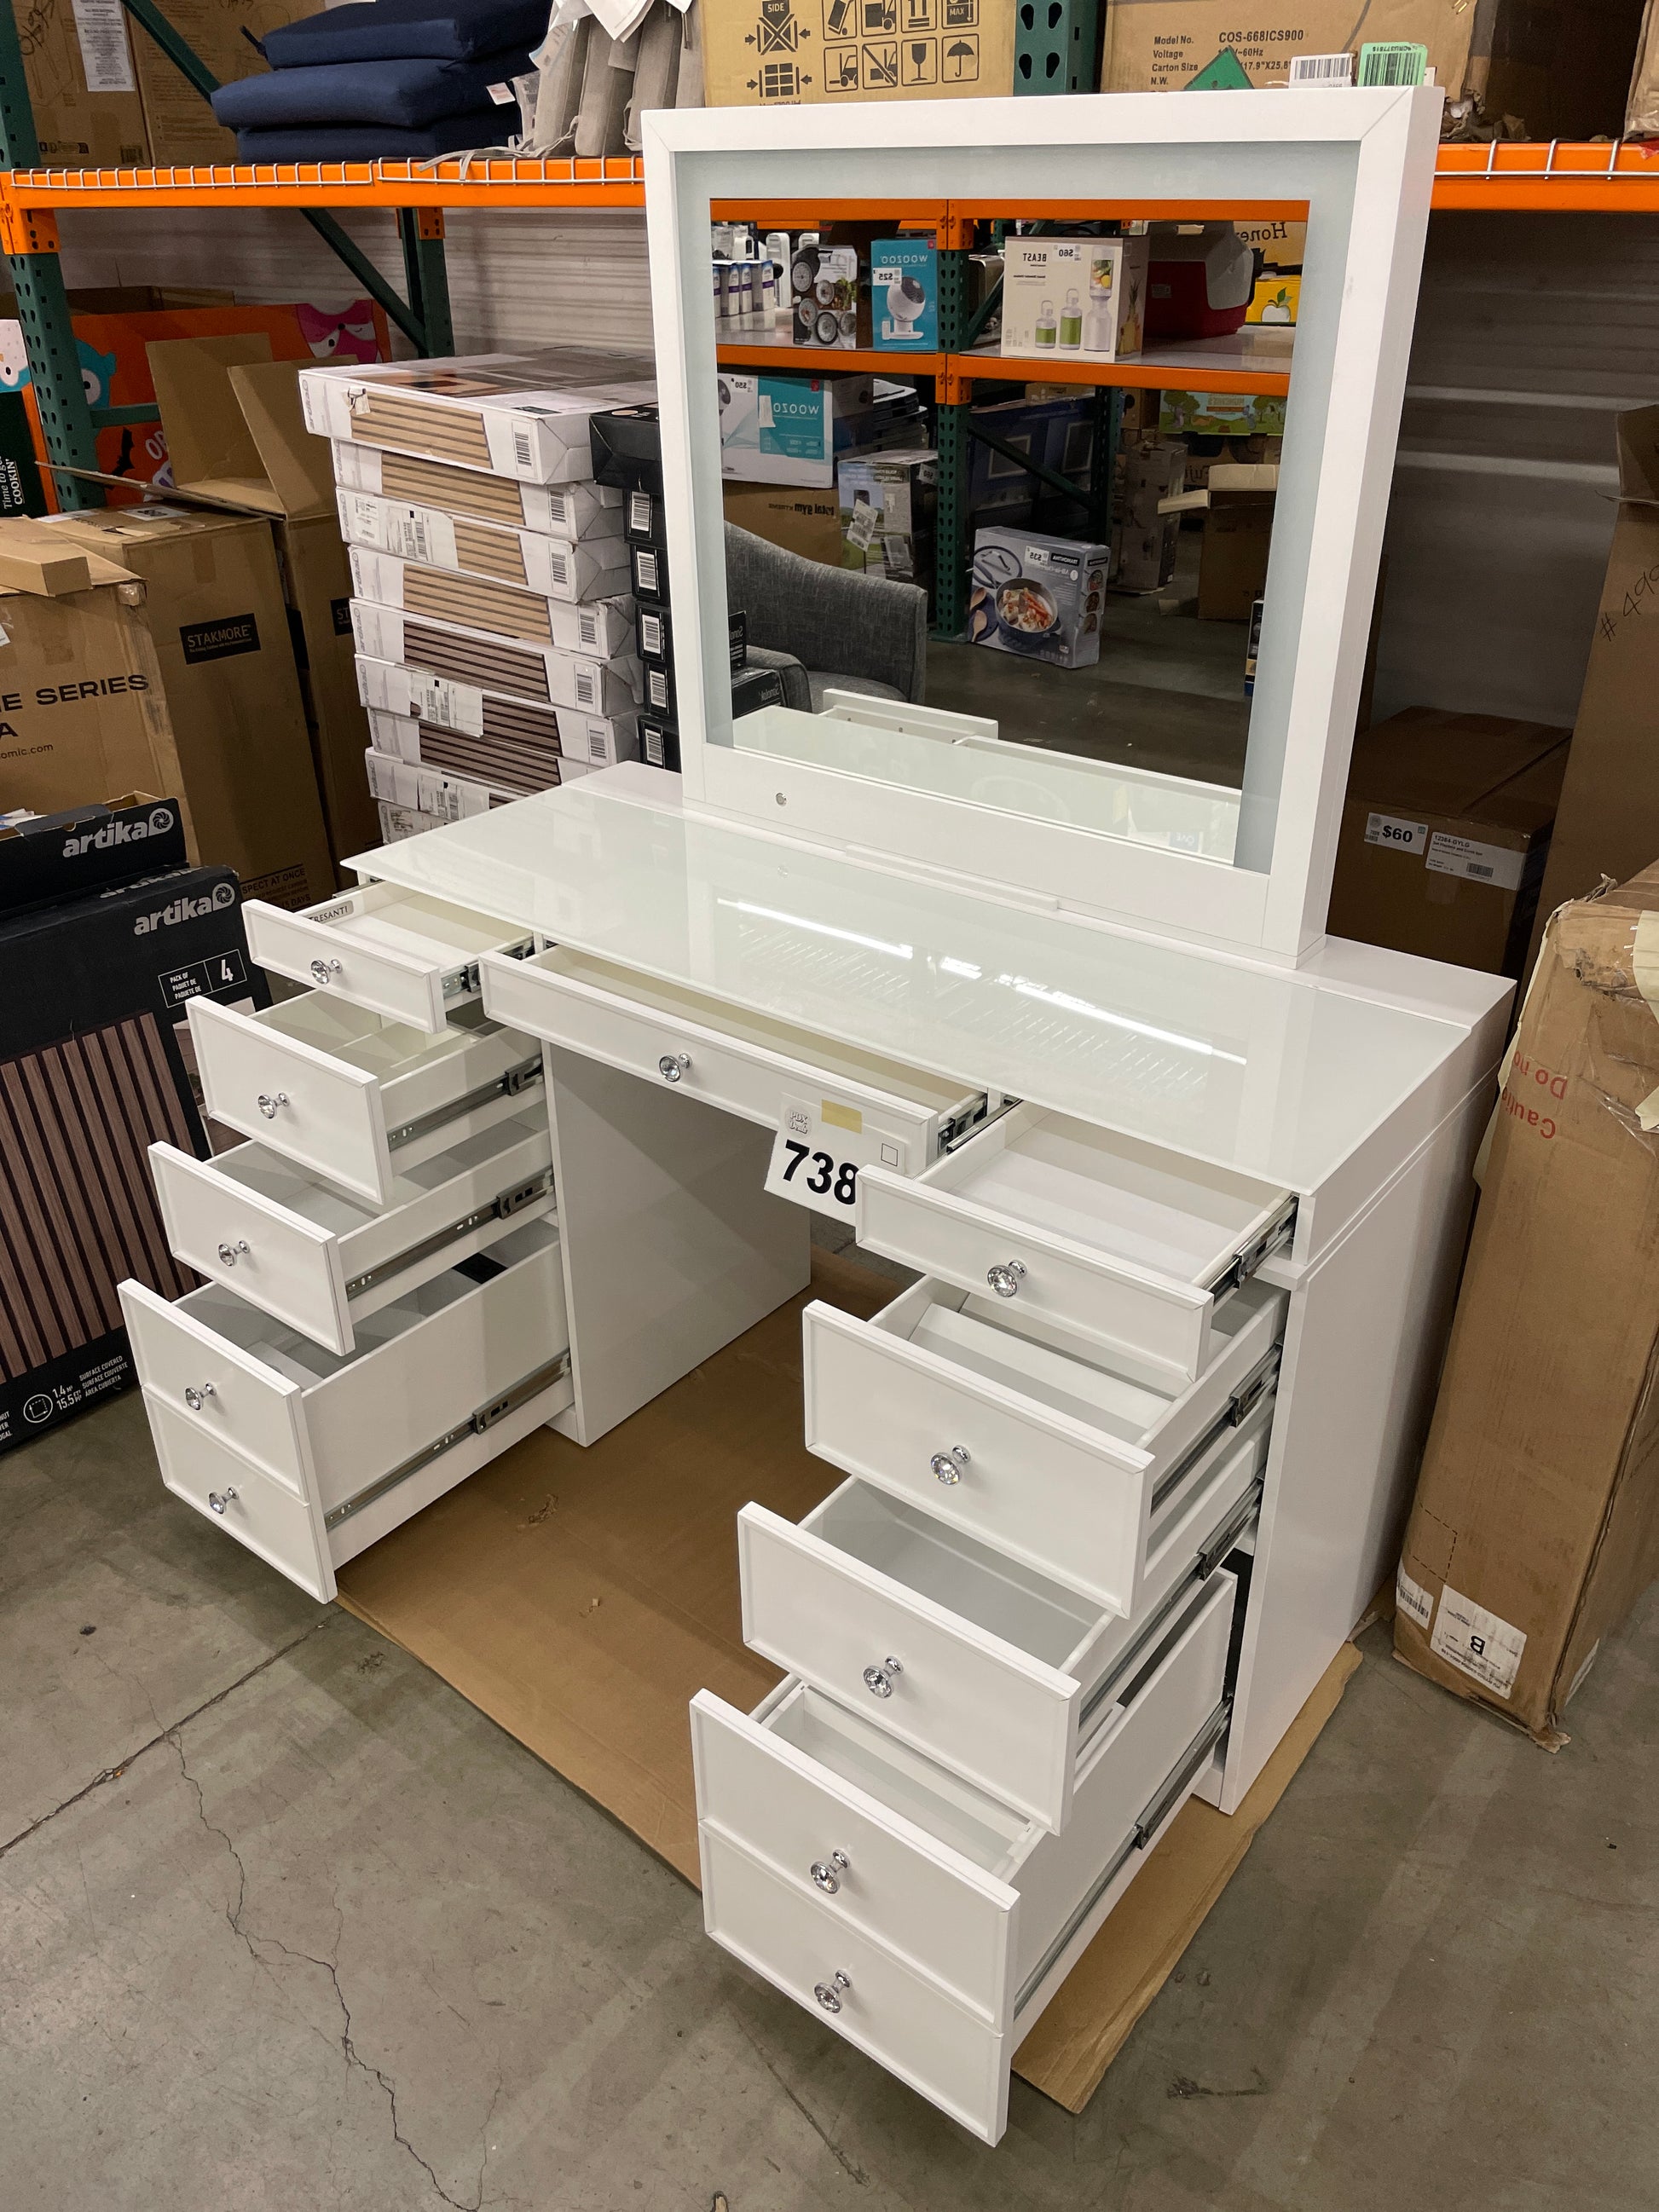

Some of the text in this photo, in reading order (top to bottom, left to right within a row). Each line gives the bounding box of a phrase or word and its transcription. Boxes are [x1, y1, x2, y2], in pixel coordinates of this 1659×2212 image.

[768, 2, 785, 13] SIDE
[950, 8, 965, 16] MAX
[1153, 36, 1179, 45] Model
[1153, 49, 1183, 60] Voltage
[1152, 62, 1199, 72] Carton Size
[1151, 77, 1169, 85] N.W.
[5, 459, 23, 505] COOKIN'
[1, 485, 13, 509] Time
[188, 625, 251, 648] STAKMORE
[36, 674, 149, 706] SERIES
[62, 821, 149, 858] artika
[1382, 824, 1413, 843] $60
[242, 881, 269, 895] SPECT
[271, 875, 280, 887] AT
[282, 869, 305, 881] ONCE
[292, 893, 311, 904] DAYS
[134, 897, 213, 936] artika
[170, 973, 182, 984] PACK
[221, 959, 234, 982] 4
[172, 979, 190, 991] PAQUET
[175, 987, 195, 1000] PAQUETE
[1535, 1067, 1569, 1101] Do
[1501, 1086, 1557, 1140] Cautio
[783, 1139, 860, 1205] 738
[79, 1355, 123, 1382] SURFACE COVERED
[82, 1361, 129, 1389] SURFACE COUVERTE
[52, 1385, 66, 1398] 1.4
[98, 1375, 122, 1391] CUBIERTA
[56, 1394, 74, 1410] 15.5
[1470, 1635, 1486, 1655] B
